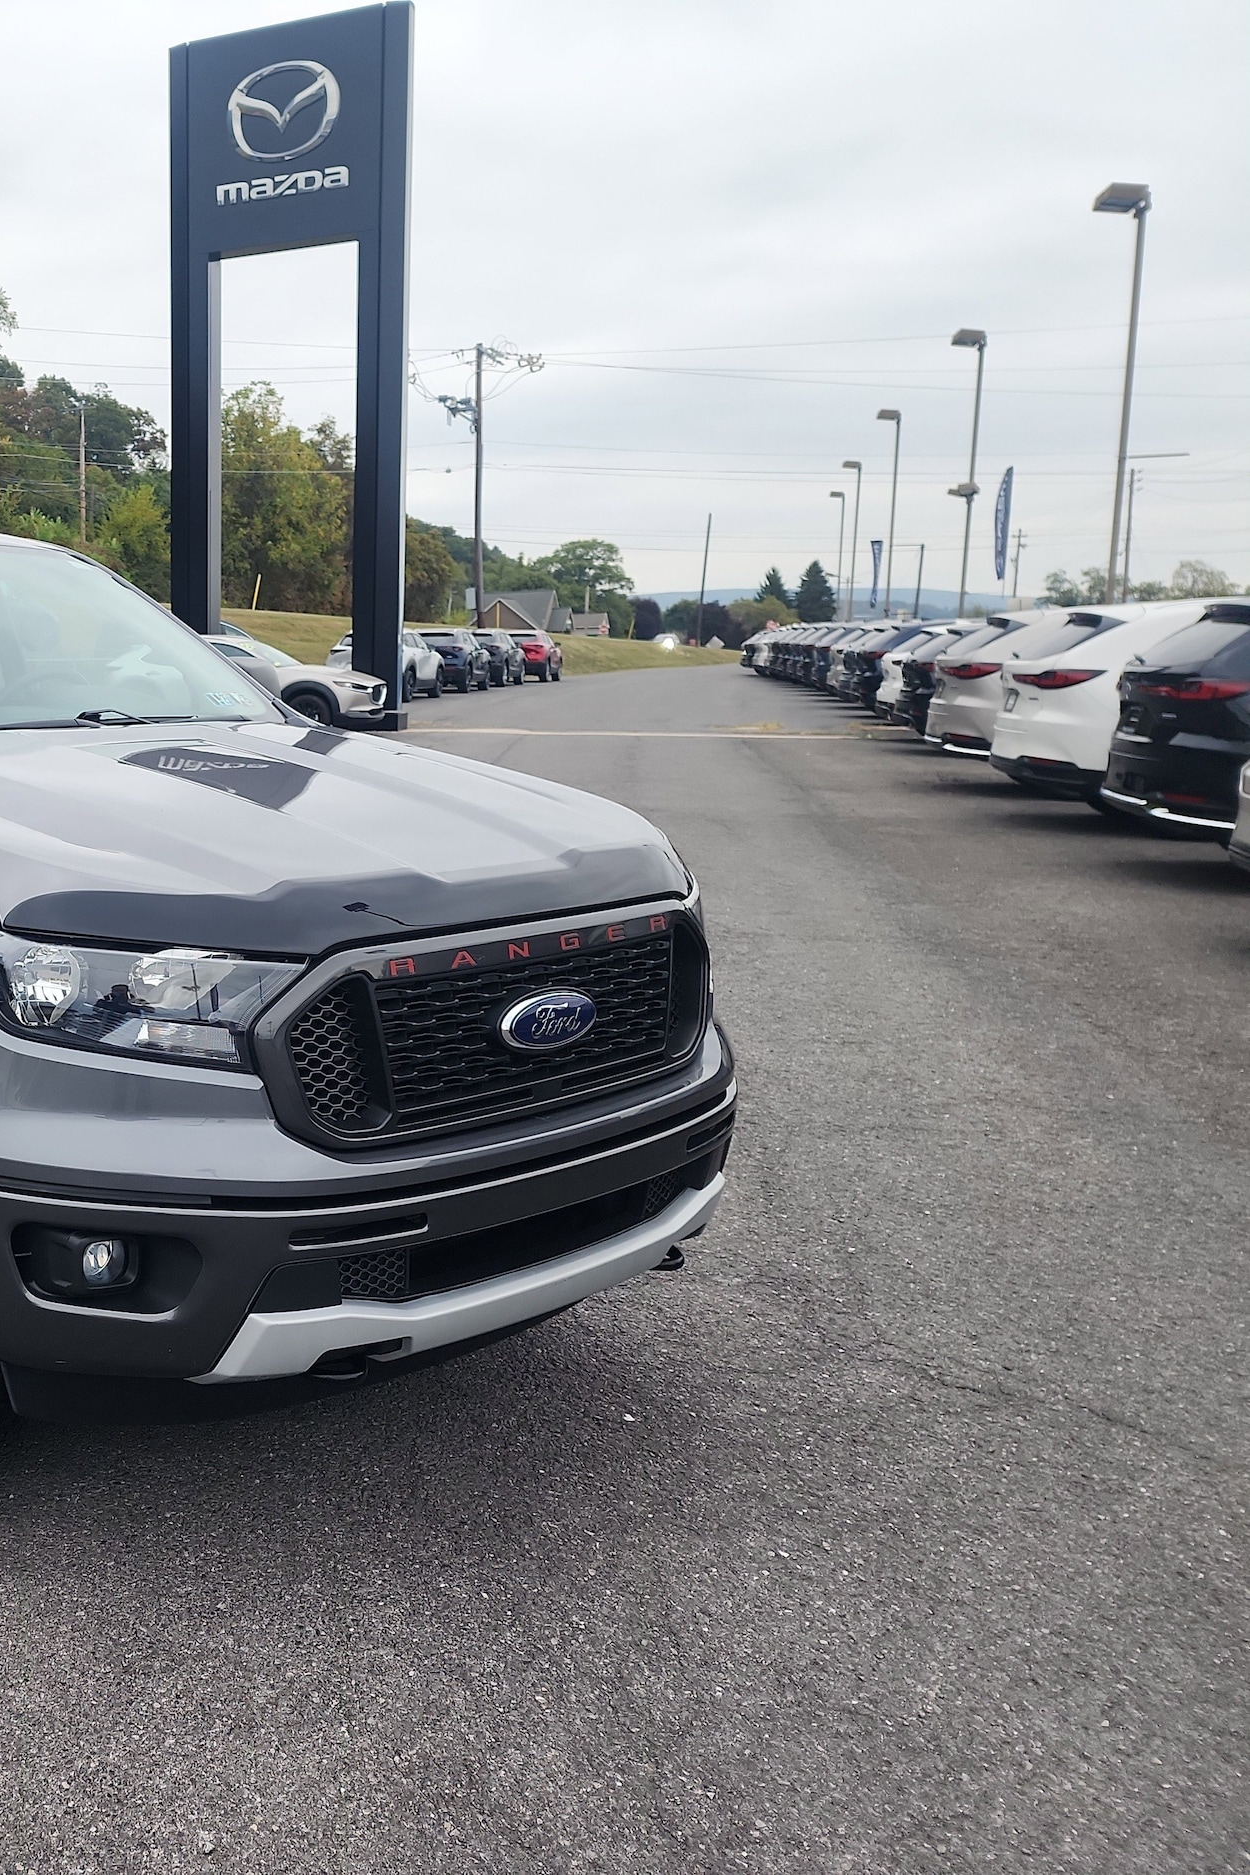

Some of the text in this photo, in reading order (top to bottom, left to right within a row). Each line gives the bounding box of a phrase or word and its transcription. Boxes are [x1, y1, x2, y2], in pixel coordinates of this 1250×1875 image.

[216, 165, 349, 205] mazda
[389, 915, 668, 977] RANGER
[531, 1002, 581, 1039] Ford
